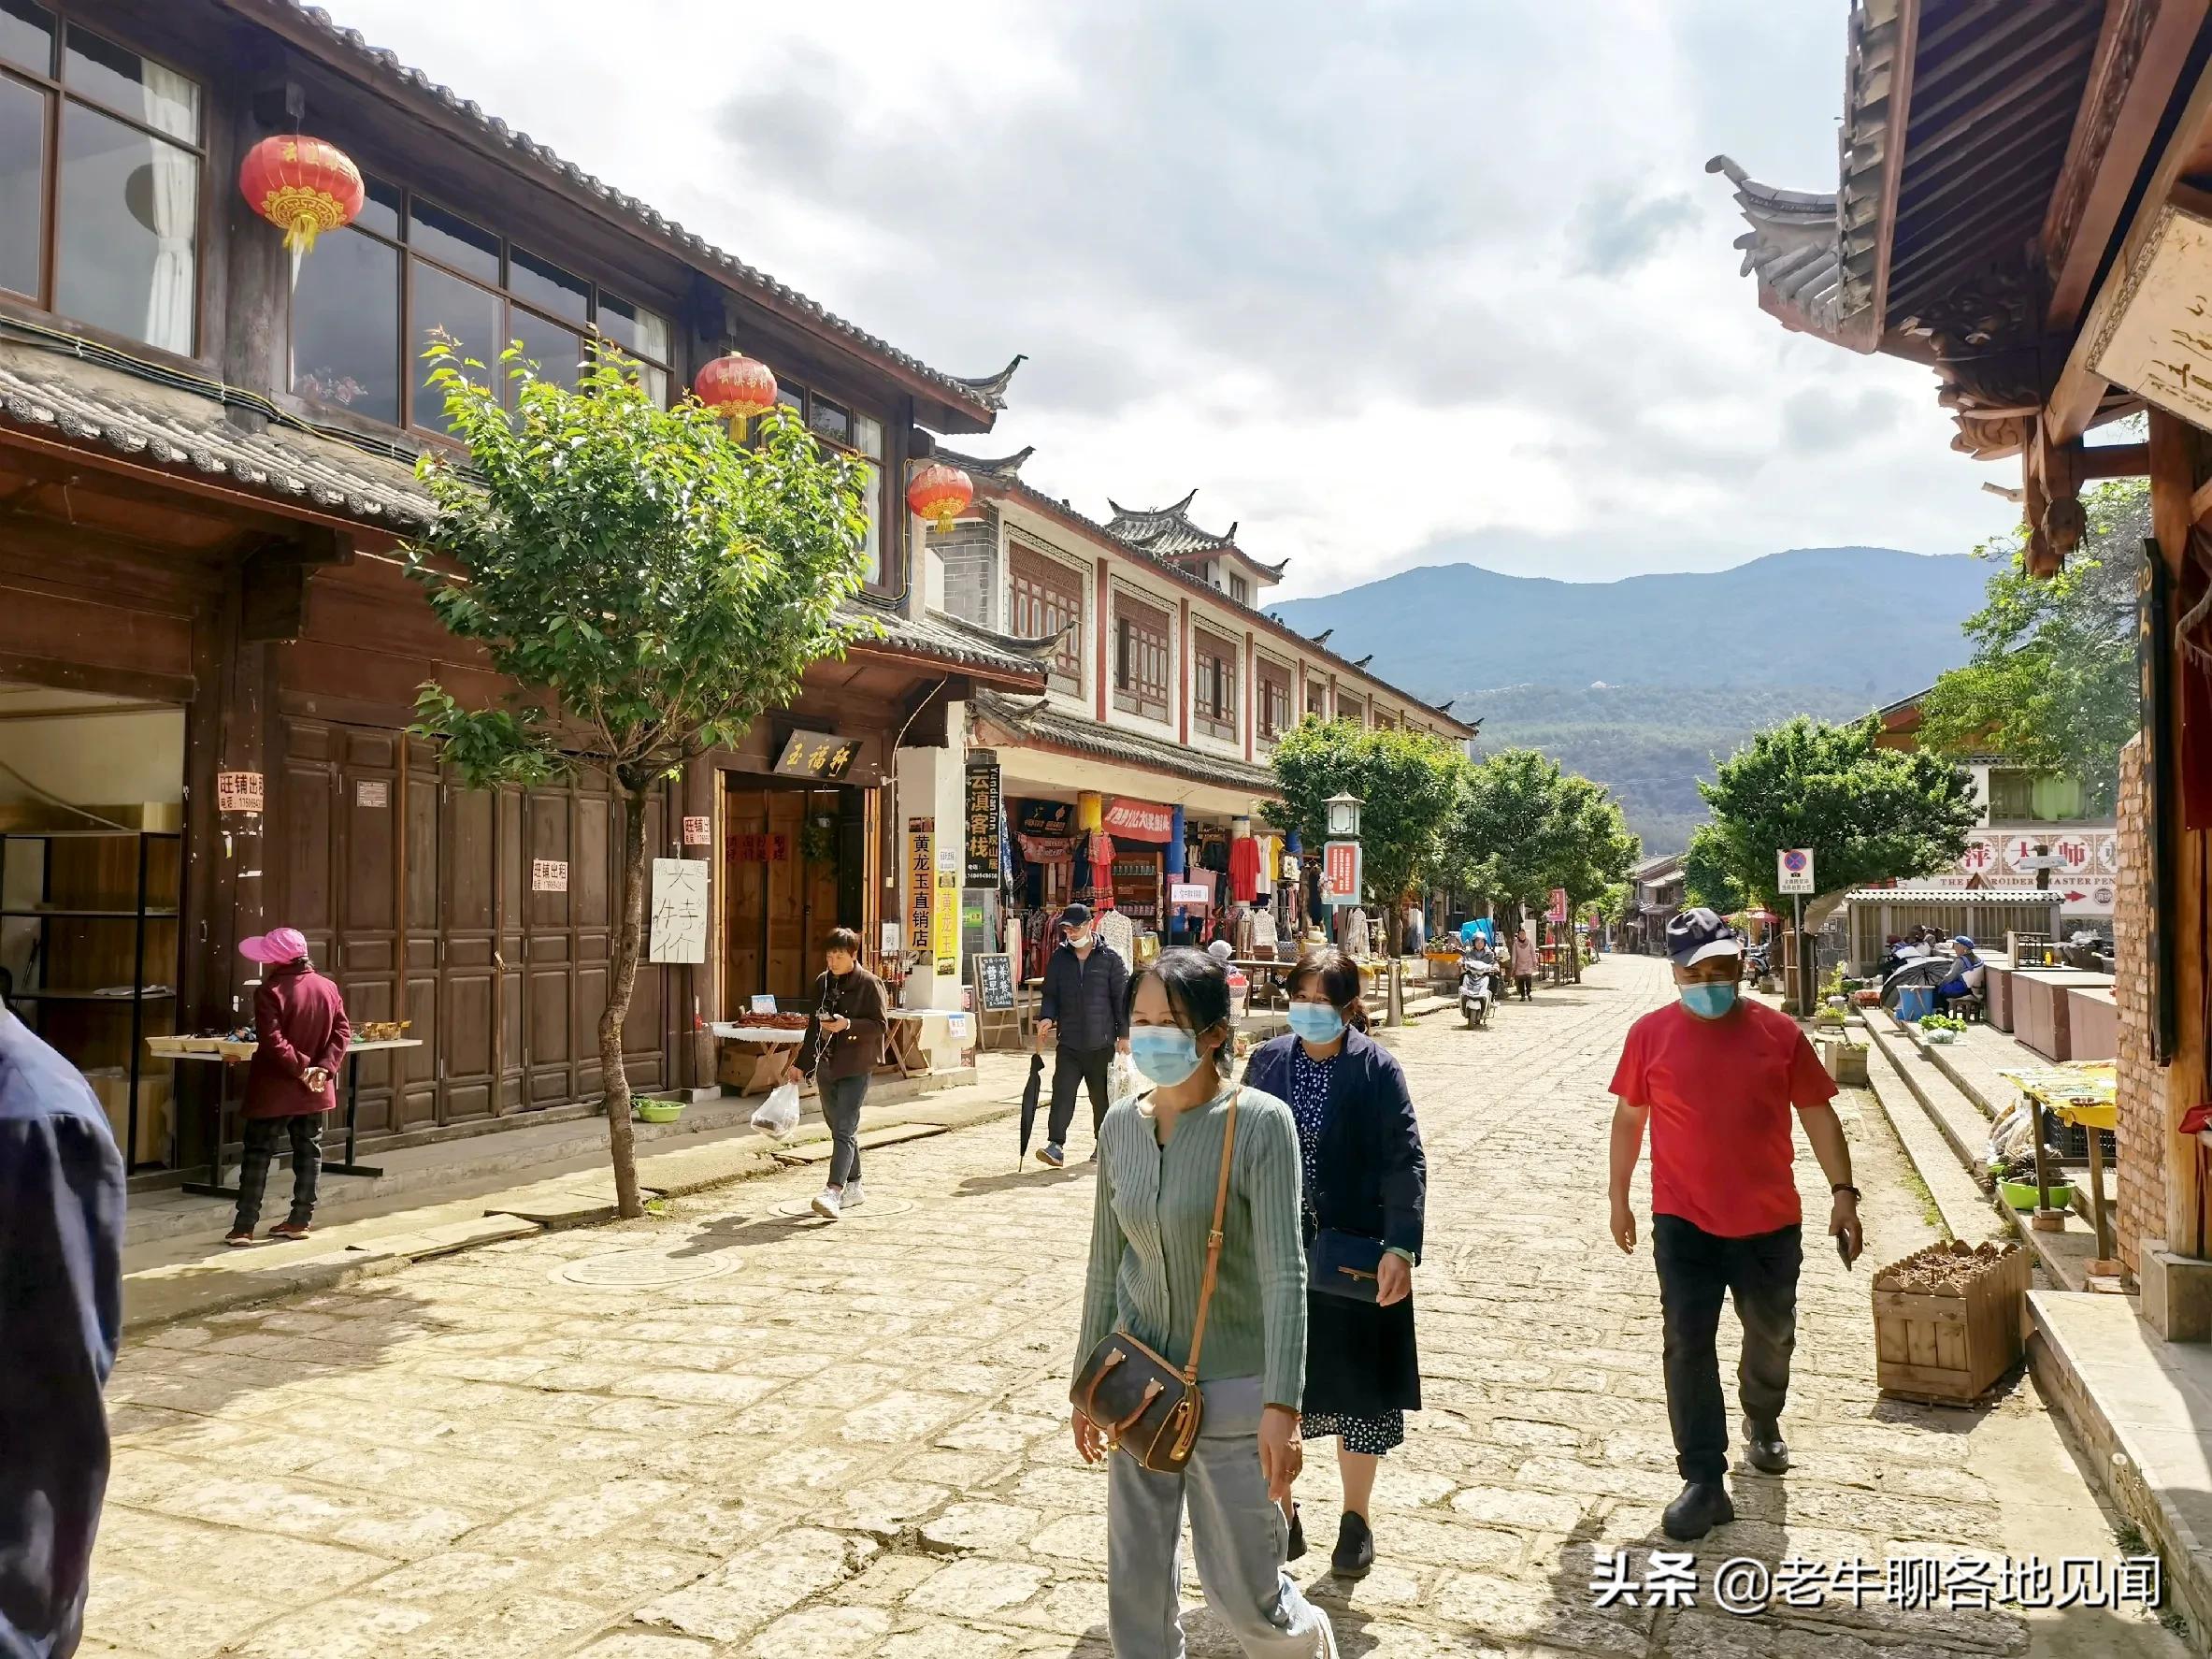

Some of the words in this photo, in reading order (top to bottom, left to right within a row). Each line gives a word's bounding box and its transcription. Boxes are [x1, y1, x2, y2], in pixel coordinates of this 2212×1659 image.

[970, 768, 990, 858] 云滇客栈
[534, 862, 567, 879] 旺铺出租
[912, 834, 930, 947] 黄龙玉直销店
[941, 891, 953, 954] 黄龙玉
